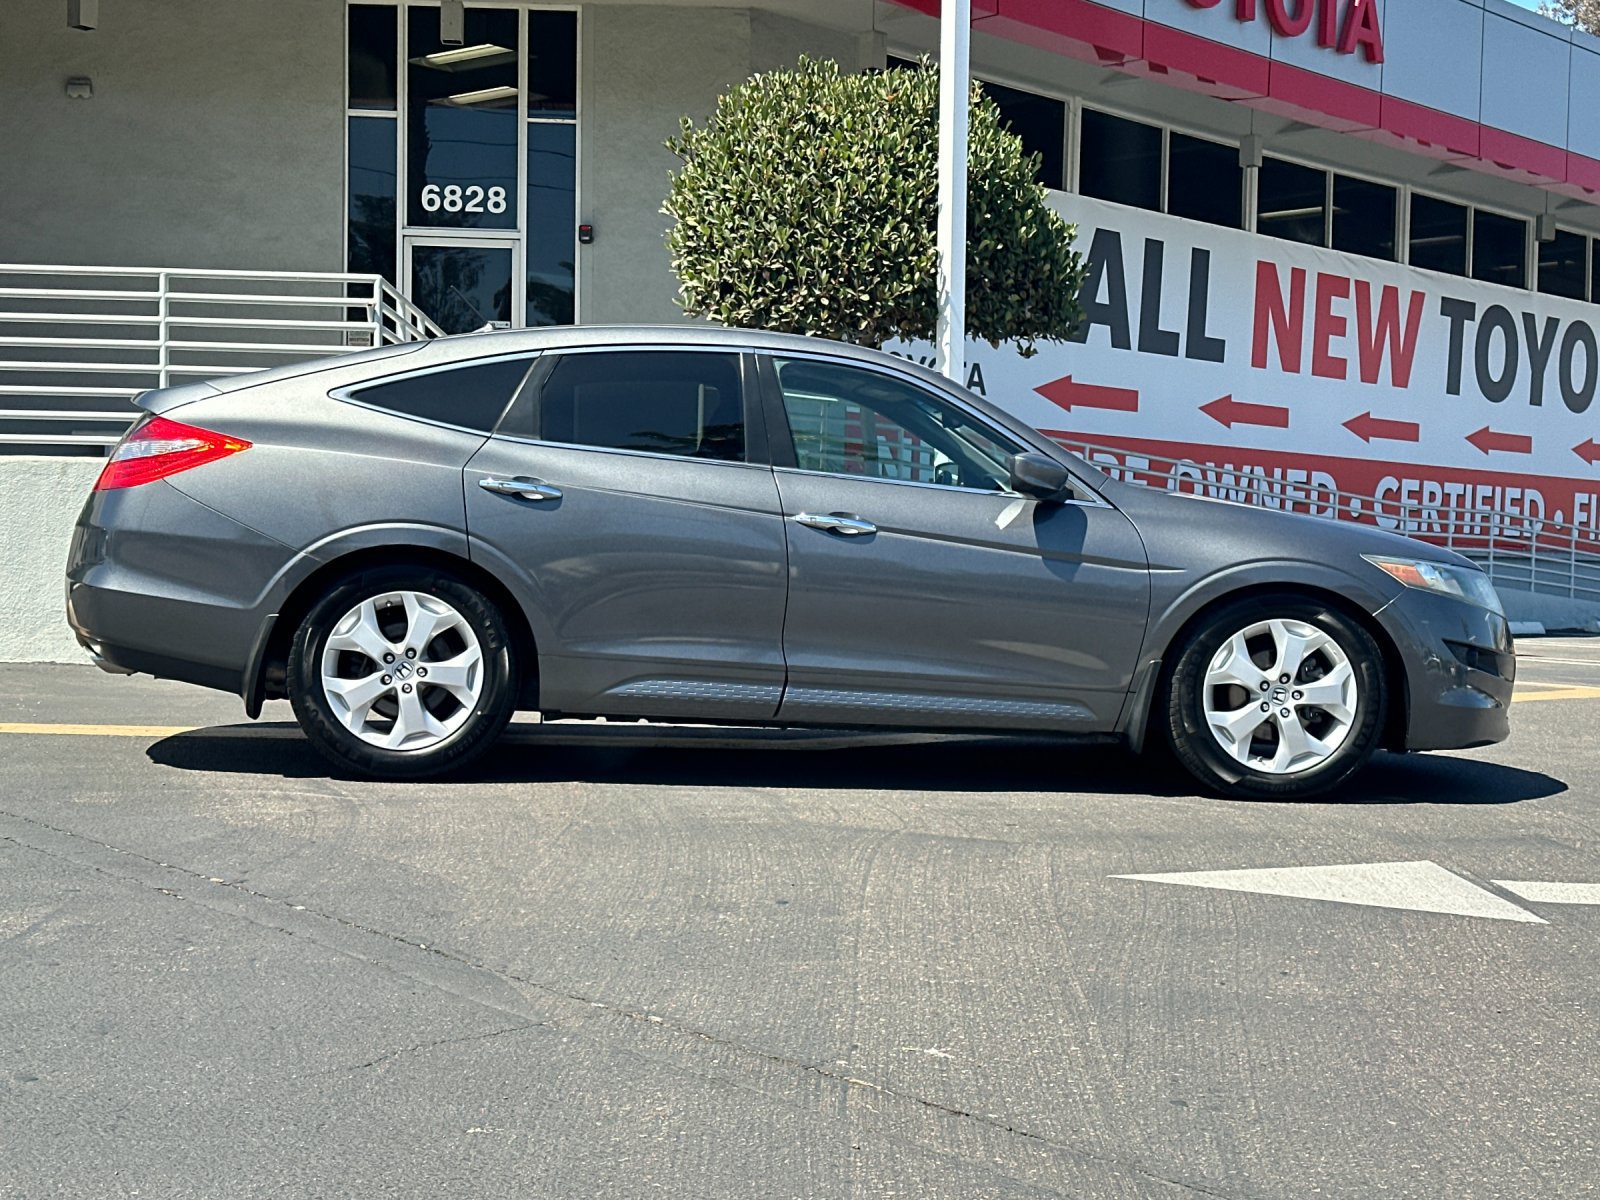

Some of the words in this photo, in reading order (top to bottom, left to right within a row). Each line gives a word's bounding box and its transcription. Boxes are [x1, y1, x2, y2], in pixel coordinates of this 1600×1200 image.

[421, 184, 507, 214] 6828
[1067, 227, 1226, 363] ALL
[1251, 260, 1426, 389] NEW
[1440, 296, 1599, 414] TOYO
[1374, 475, 1546, 538] CERTIFIED
[1574, 493, 1600, 541] FI
